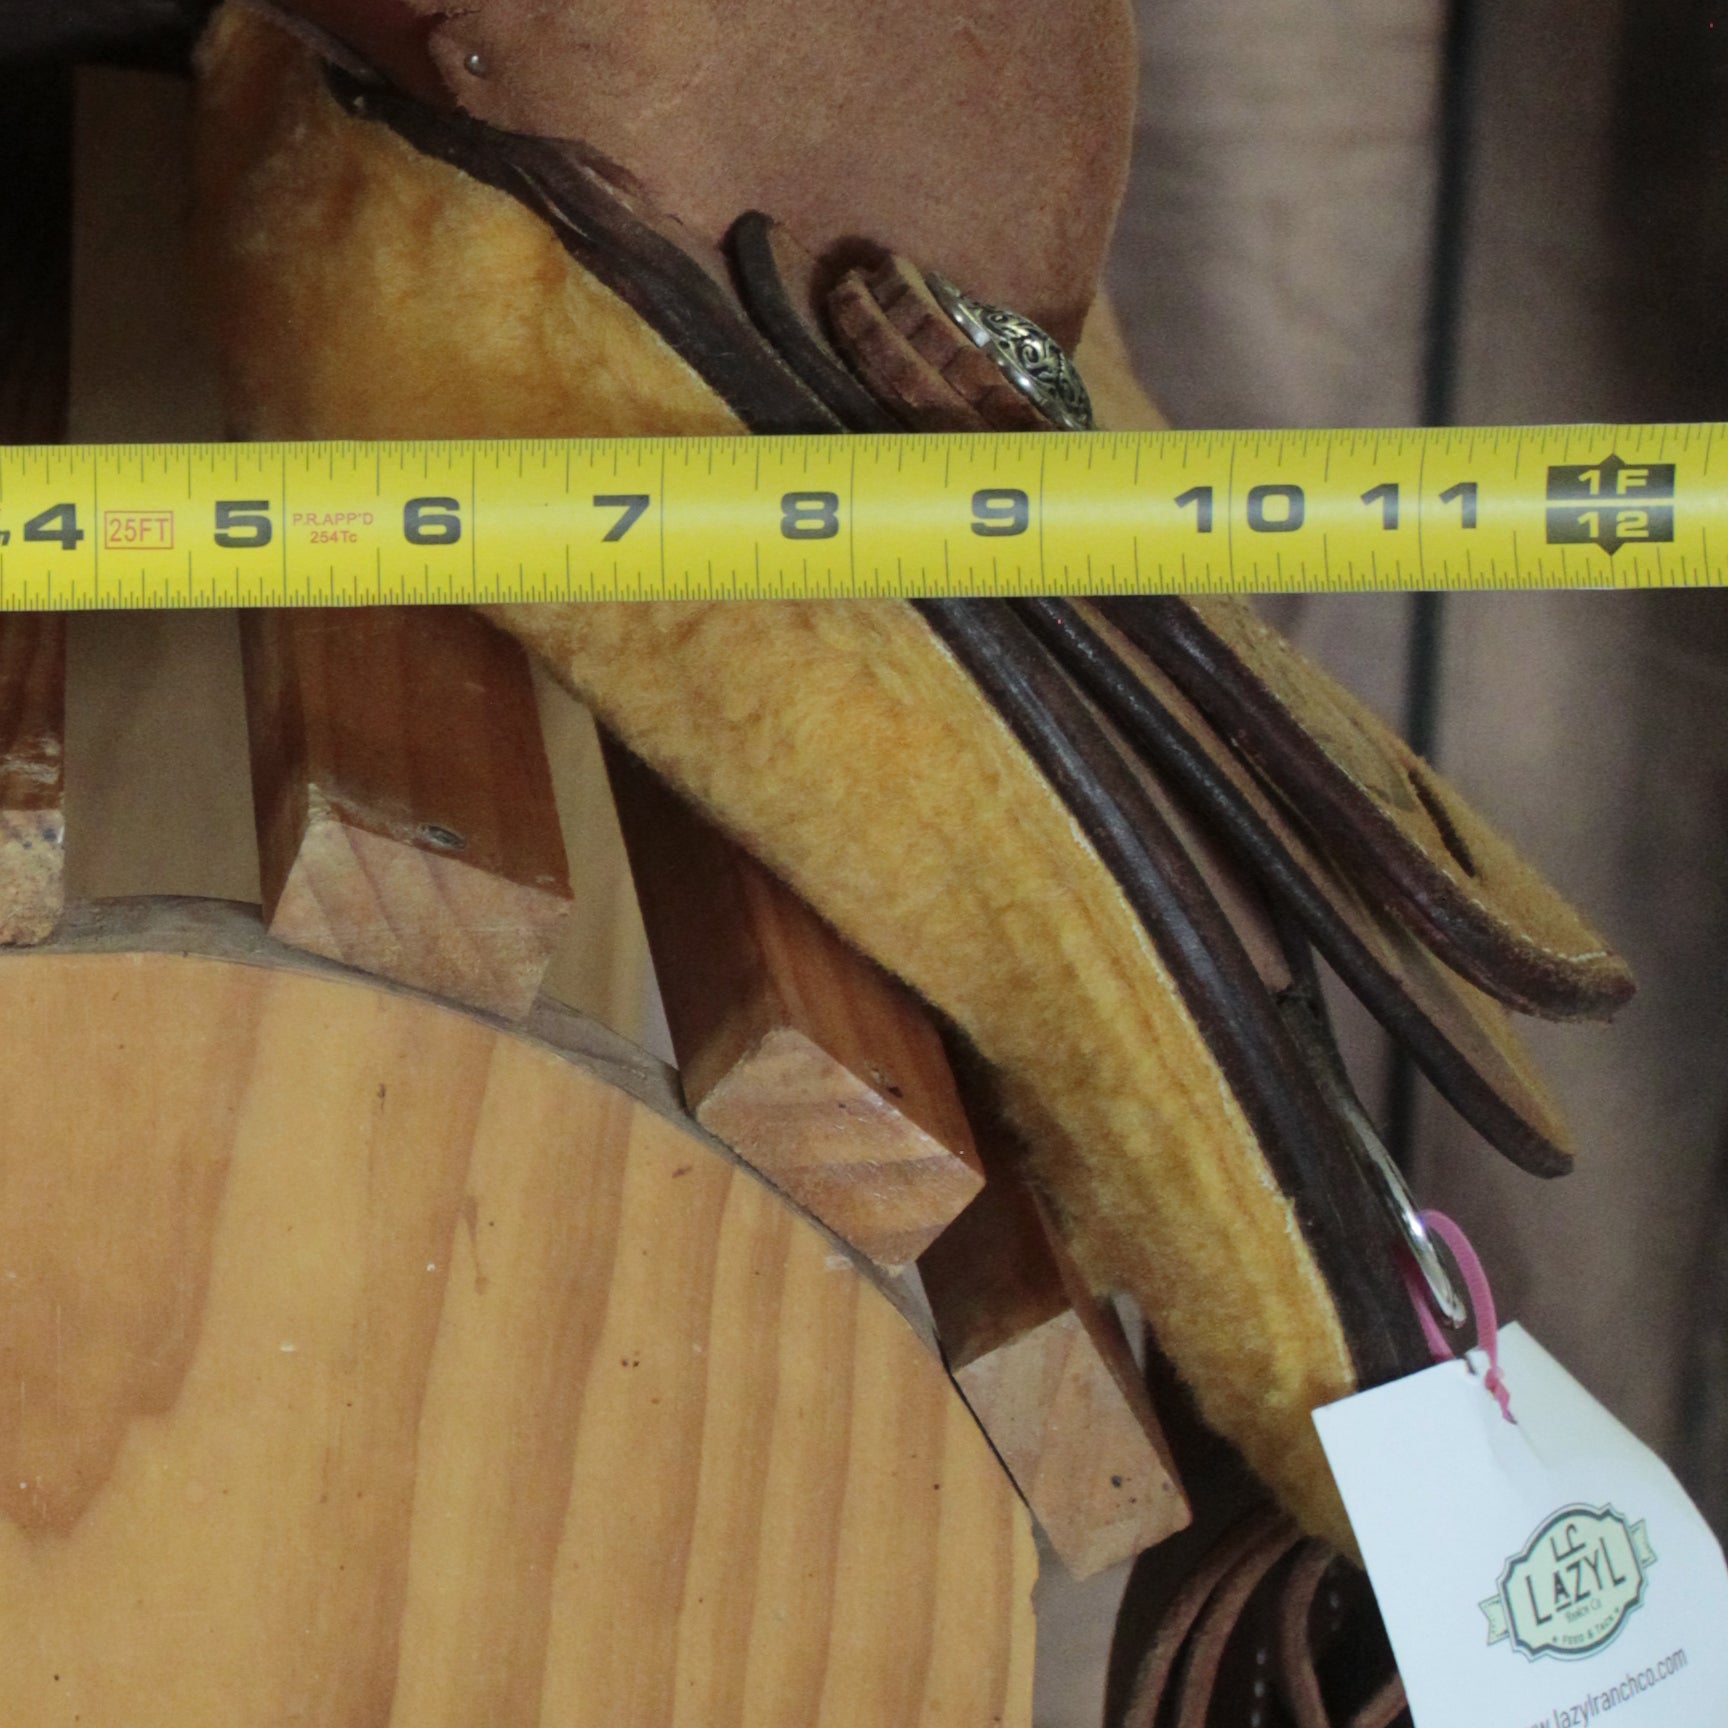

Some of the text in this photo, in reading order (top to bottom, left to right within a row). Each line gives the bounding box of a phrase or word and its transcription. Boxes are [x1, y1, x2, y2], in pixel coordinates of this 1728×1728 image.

[1577, 469, 1649, 495] 1F
[24, 503, 84, 550] 4
[110, 518, 168, 542] 25FT
[214, 500, 272, 548] 5
[403, 497, 462, 545] 6
[593, 495, 650, 542] 7
[780, 491, 839, 539] 8
[971, 489, 1029, 536] 9
[1174, 484, 1305, 533] 10
[1360, 482, 1478, 531] 11
[1576, 511, 1649, 538] 12
